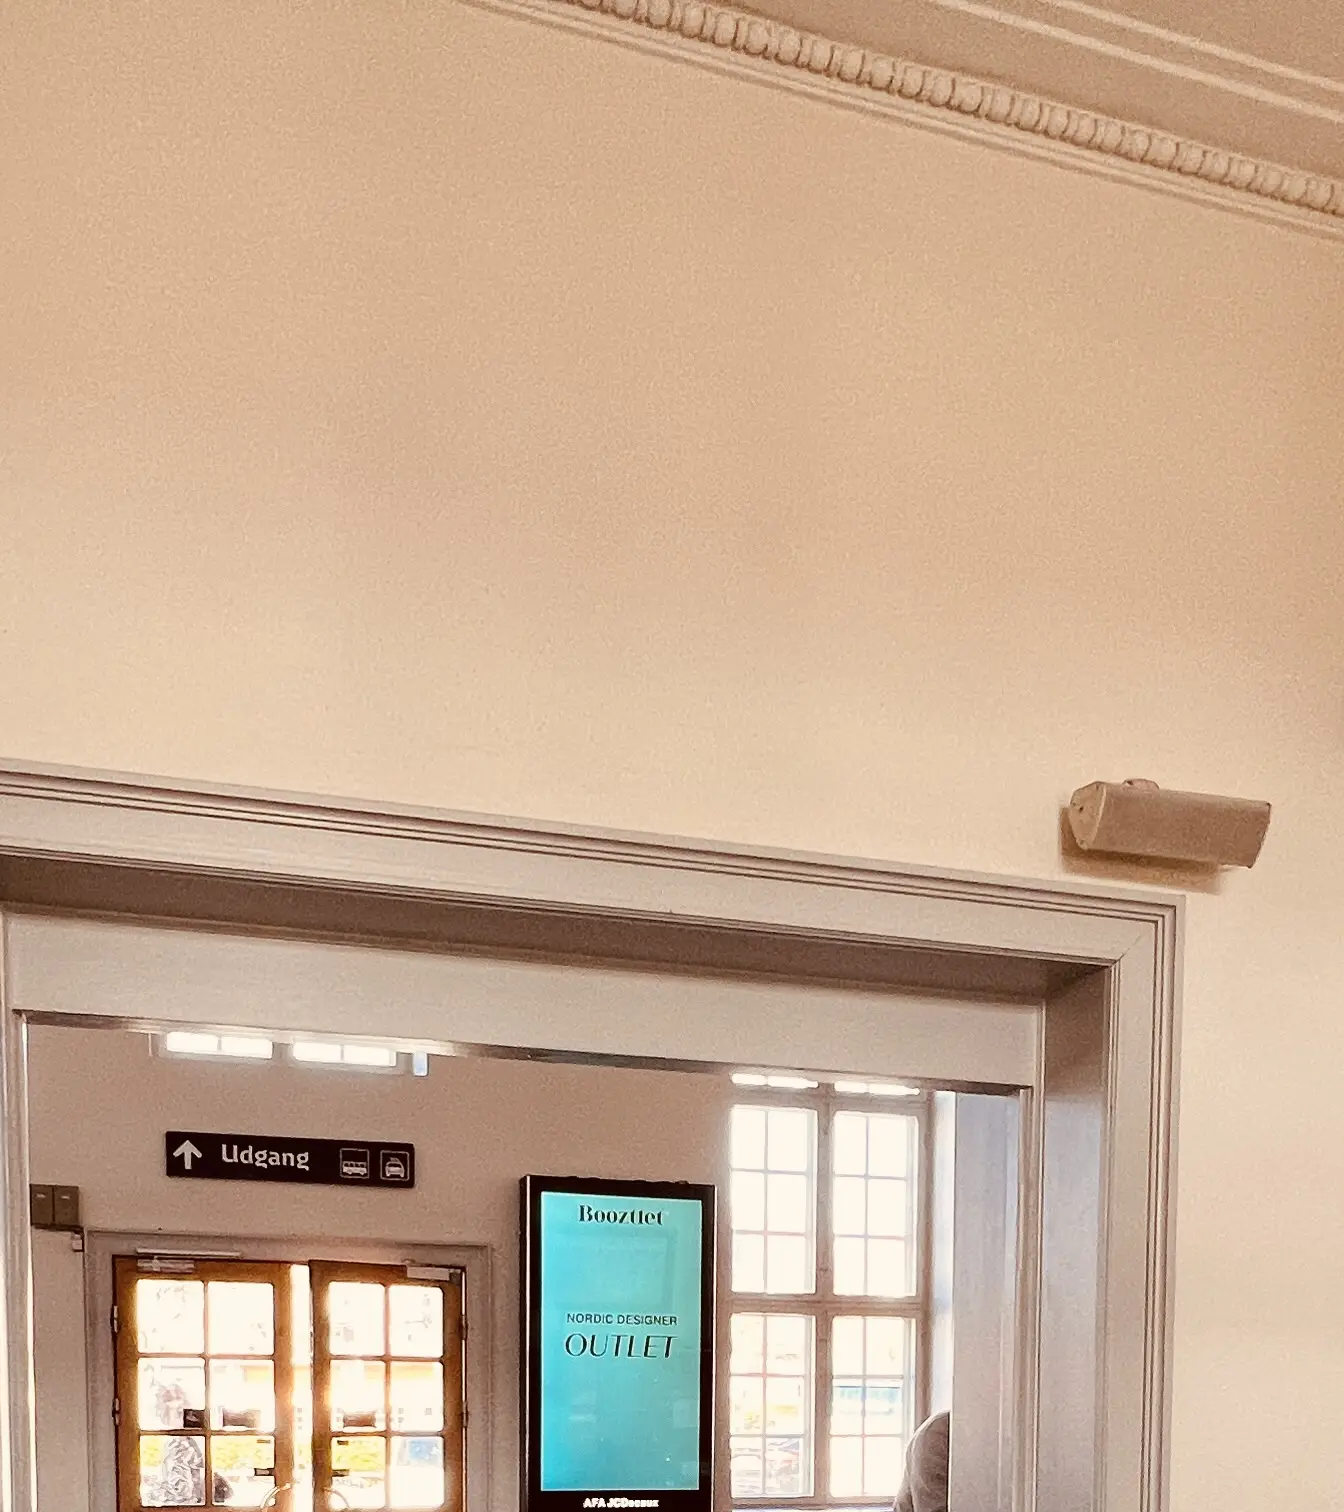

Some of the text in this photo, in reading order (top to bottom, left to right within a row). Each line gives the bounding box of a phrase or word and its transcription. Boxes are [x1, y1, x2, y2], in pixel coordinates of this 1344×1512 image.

[221, 1143, 310, 1171] Udgang
[578, 1204, 663, 1226] Booztlet
[566, 1313, 677, 1326] NORDIC DESIGNER
[565, 1333, 678, 1358] OUTLET
[582, 1497, 606, 1508] AFA
